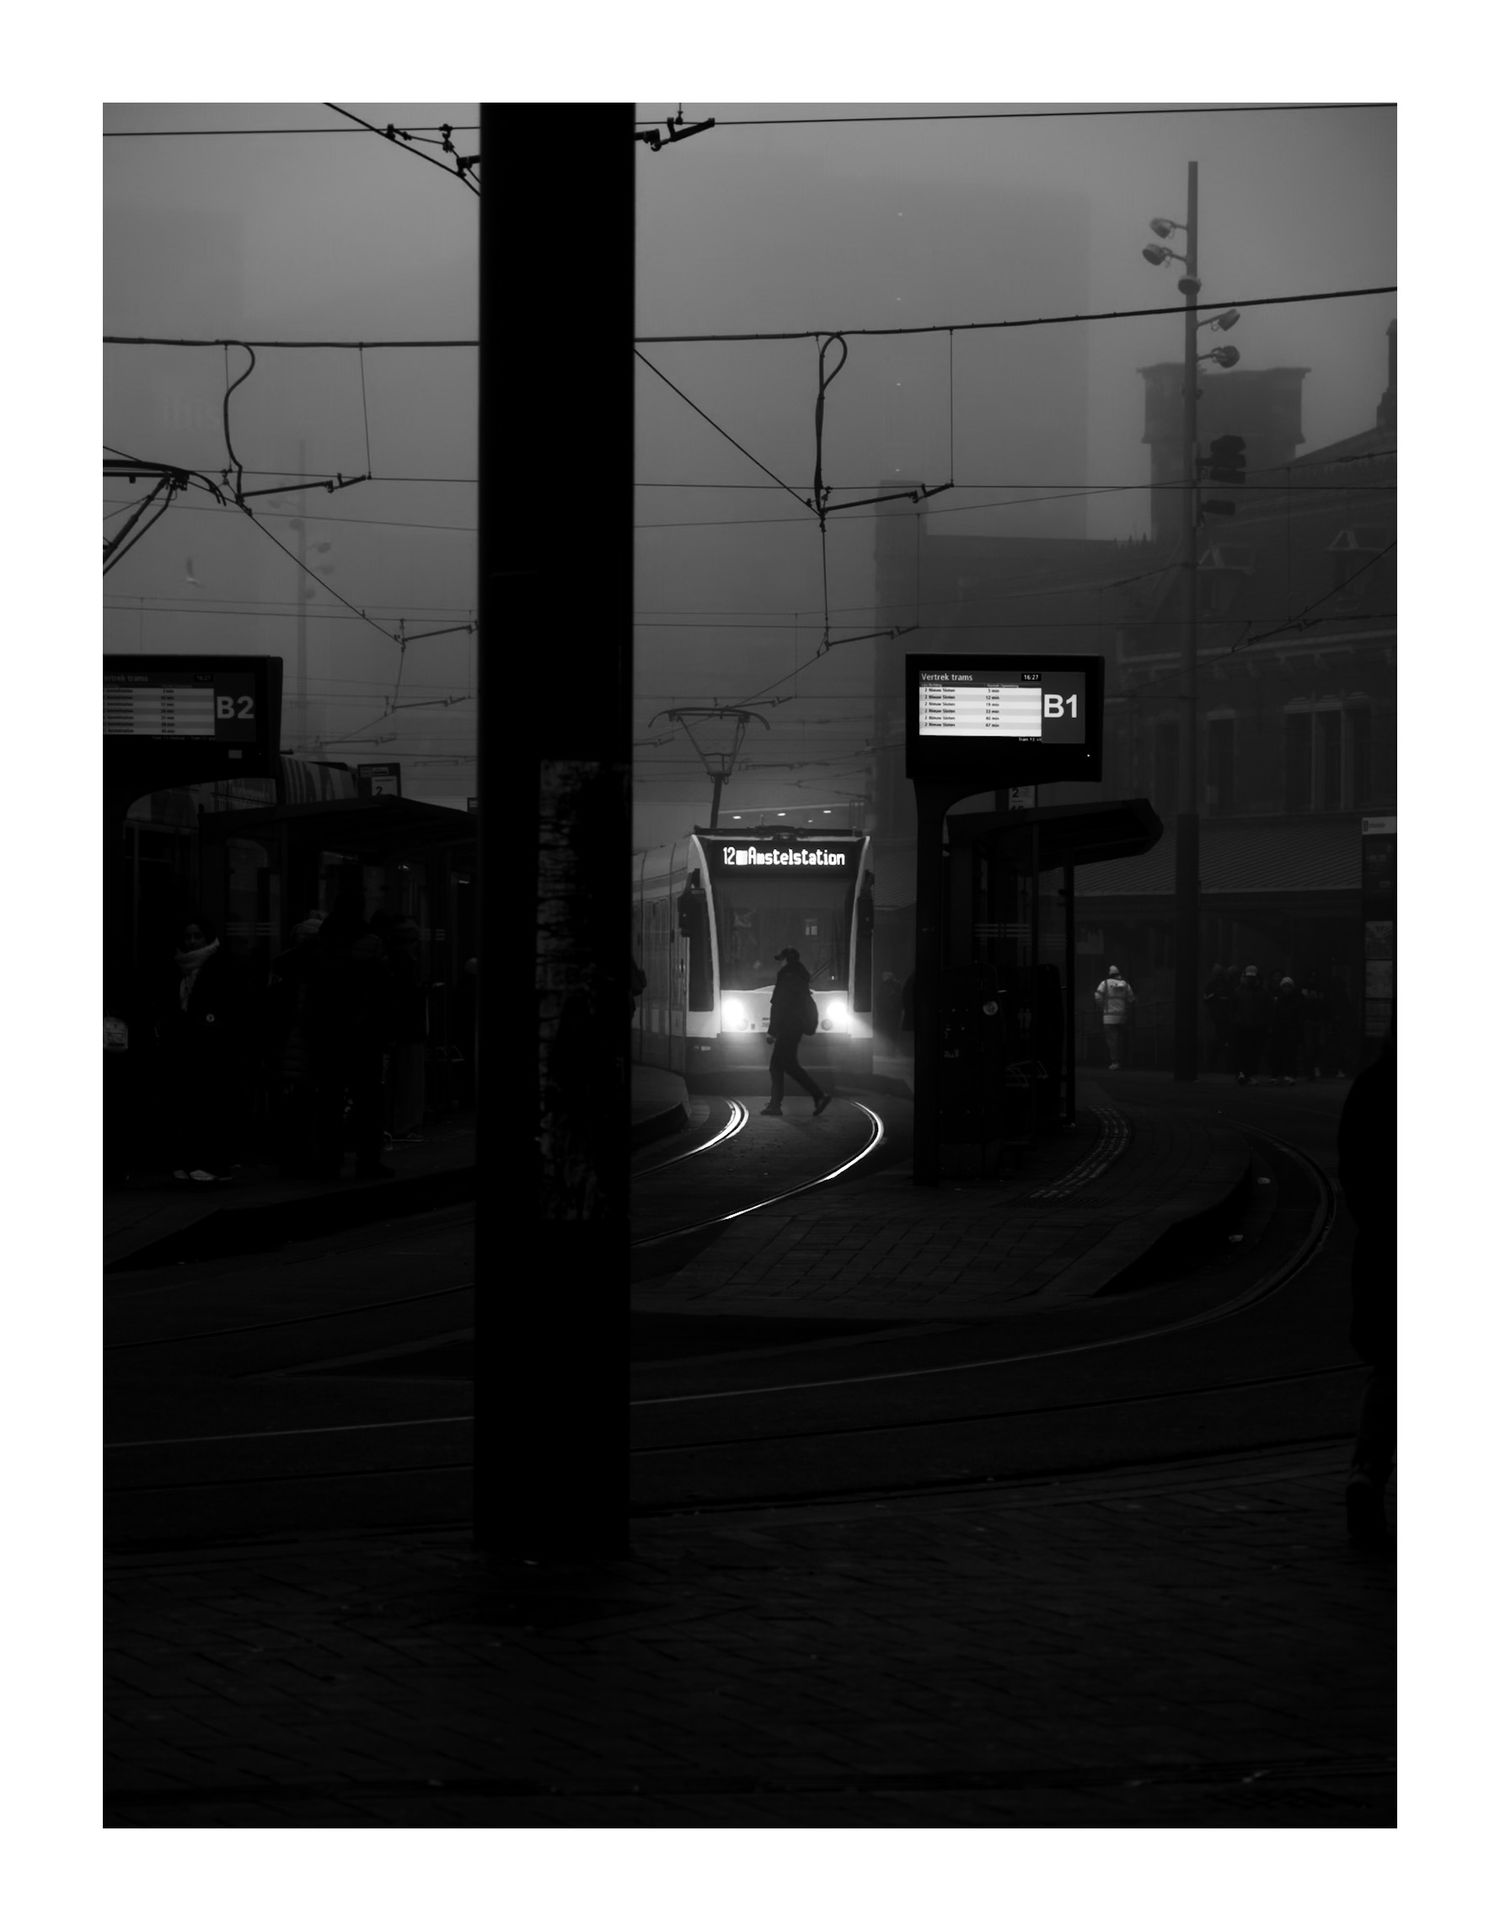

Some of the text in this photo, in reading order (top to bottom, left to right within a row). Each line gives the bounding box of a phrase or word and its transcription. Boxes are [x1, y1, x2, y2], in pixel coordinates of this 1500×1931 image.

[921, 673, 973, 682] Vertrek trams
[216, 695, 255, 719] B2
[1043, 694, 1078, 718] B1
[723, 846, 845, 865] 12 Amstelstation
